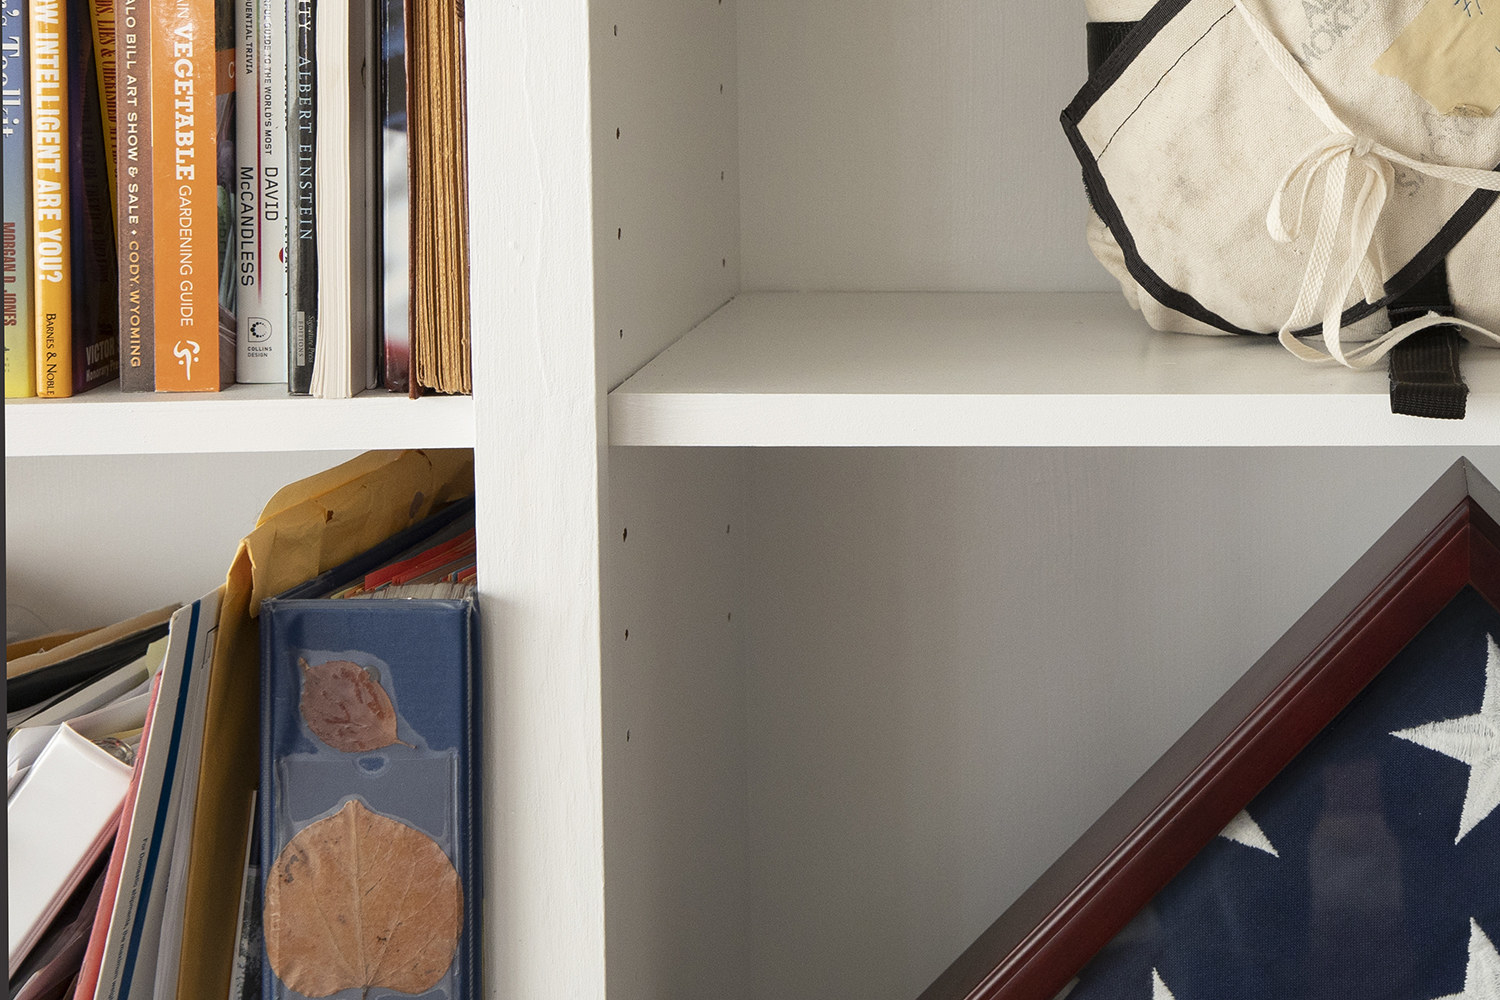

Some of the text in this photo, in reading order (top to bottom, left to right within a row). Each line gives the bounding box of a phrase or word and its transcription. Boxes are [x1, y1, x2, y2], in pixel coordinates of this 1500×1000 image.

[97, 19, 116, 47] LIES
[125, 33, 138, 70] BILL
[245, 41, 253, 75] TRIVIA
[263, 67, 272, 84] THE
[2, 36, 21, 139] Toolkit
[34, 32, 62, 174] INTELLIGENT
[126, 74, 138, 107] ART
[173, 25, 196, 181] VEGETABLE
[264, 86, 272, 128] WORLD'S
[127, 111, 139, 162] SHOW
[264, 129, 272, 156] MOST
[299, 56, 313, 240] ALBERT EINSTEIN
[127, 166, 139, 178] &
[264, 166, 279, 222] DAVID
[36, 179, 62, 222] ARE
[128, 183, 140, 225] SALE
[4, 222, 17, 272] MORGAN
[179, 184, 194, 276] GARDENING
[241, 166, 254, 287] McCANDLESS
[38, 227, 64, 283] YOU?
[4, 289, 18, 327] JONES
[180, 279, 195, 327] GUIDE
[130, 291, 142, 368] WYOMING
[297, 320, 305, 358] EDITIONS
[45, 313, 58, 396] BARNES & NOBLE
